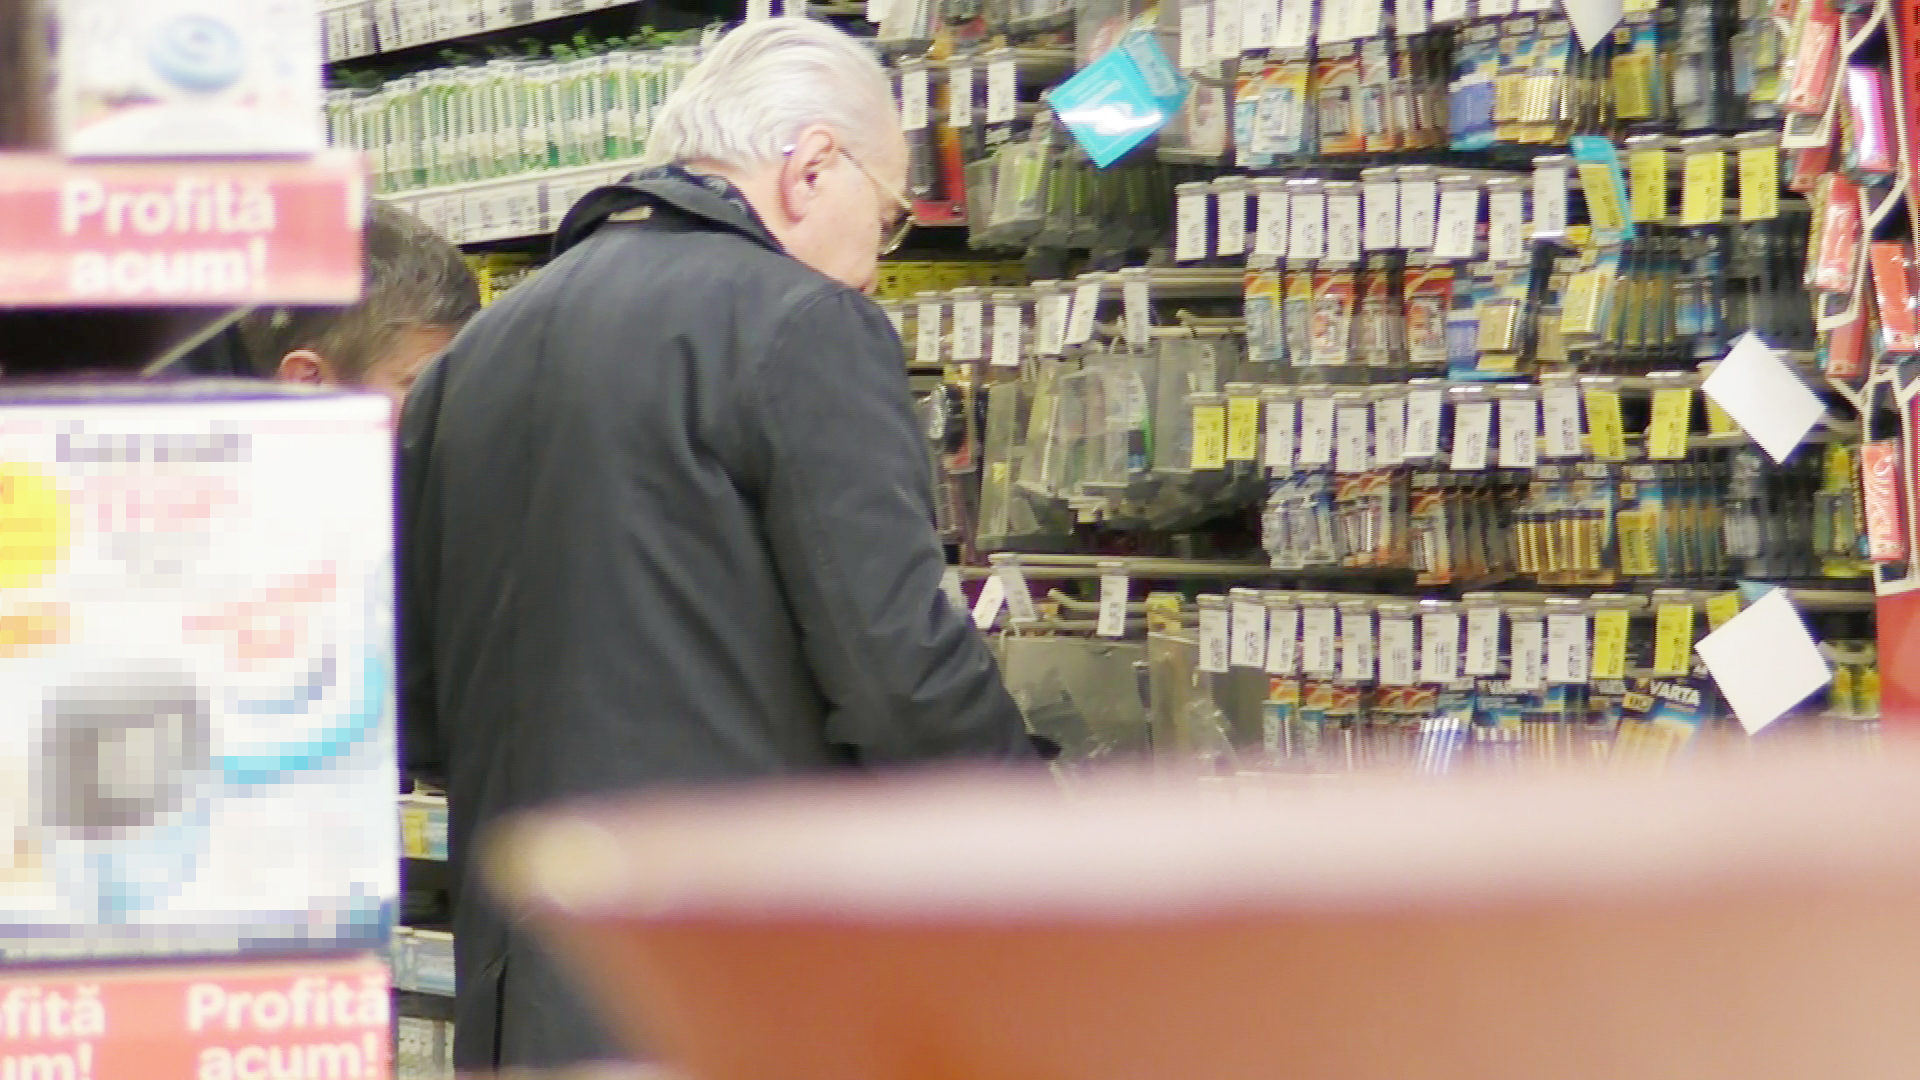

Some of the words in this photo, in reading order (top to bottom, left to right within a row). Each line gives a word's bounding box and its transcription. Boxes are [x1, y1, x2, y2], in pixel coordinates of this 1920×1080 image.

[61, 176, 275, 236] Profită
[68, 237, 267, 294] acum!
[1650, 680, 1701, 706] VARTA
[0, 984, 105, 1037] fită
[186, 975, 390, 1032] Profită
[198, 1031, 378, 1080] acum!
